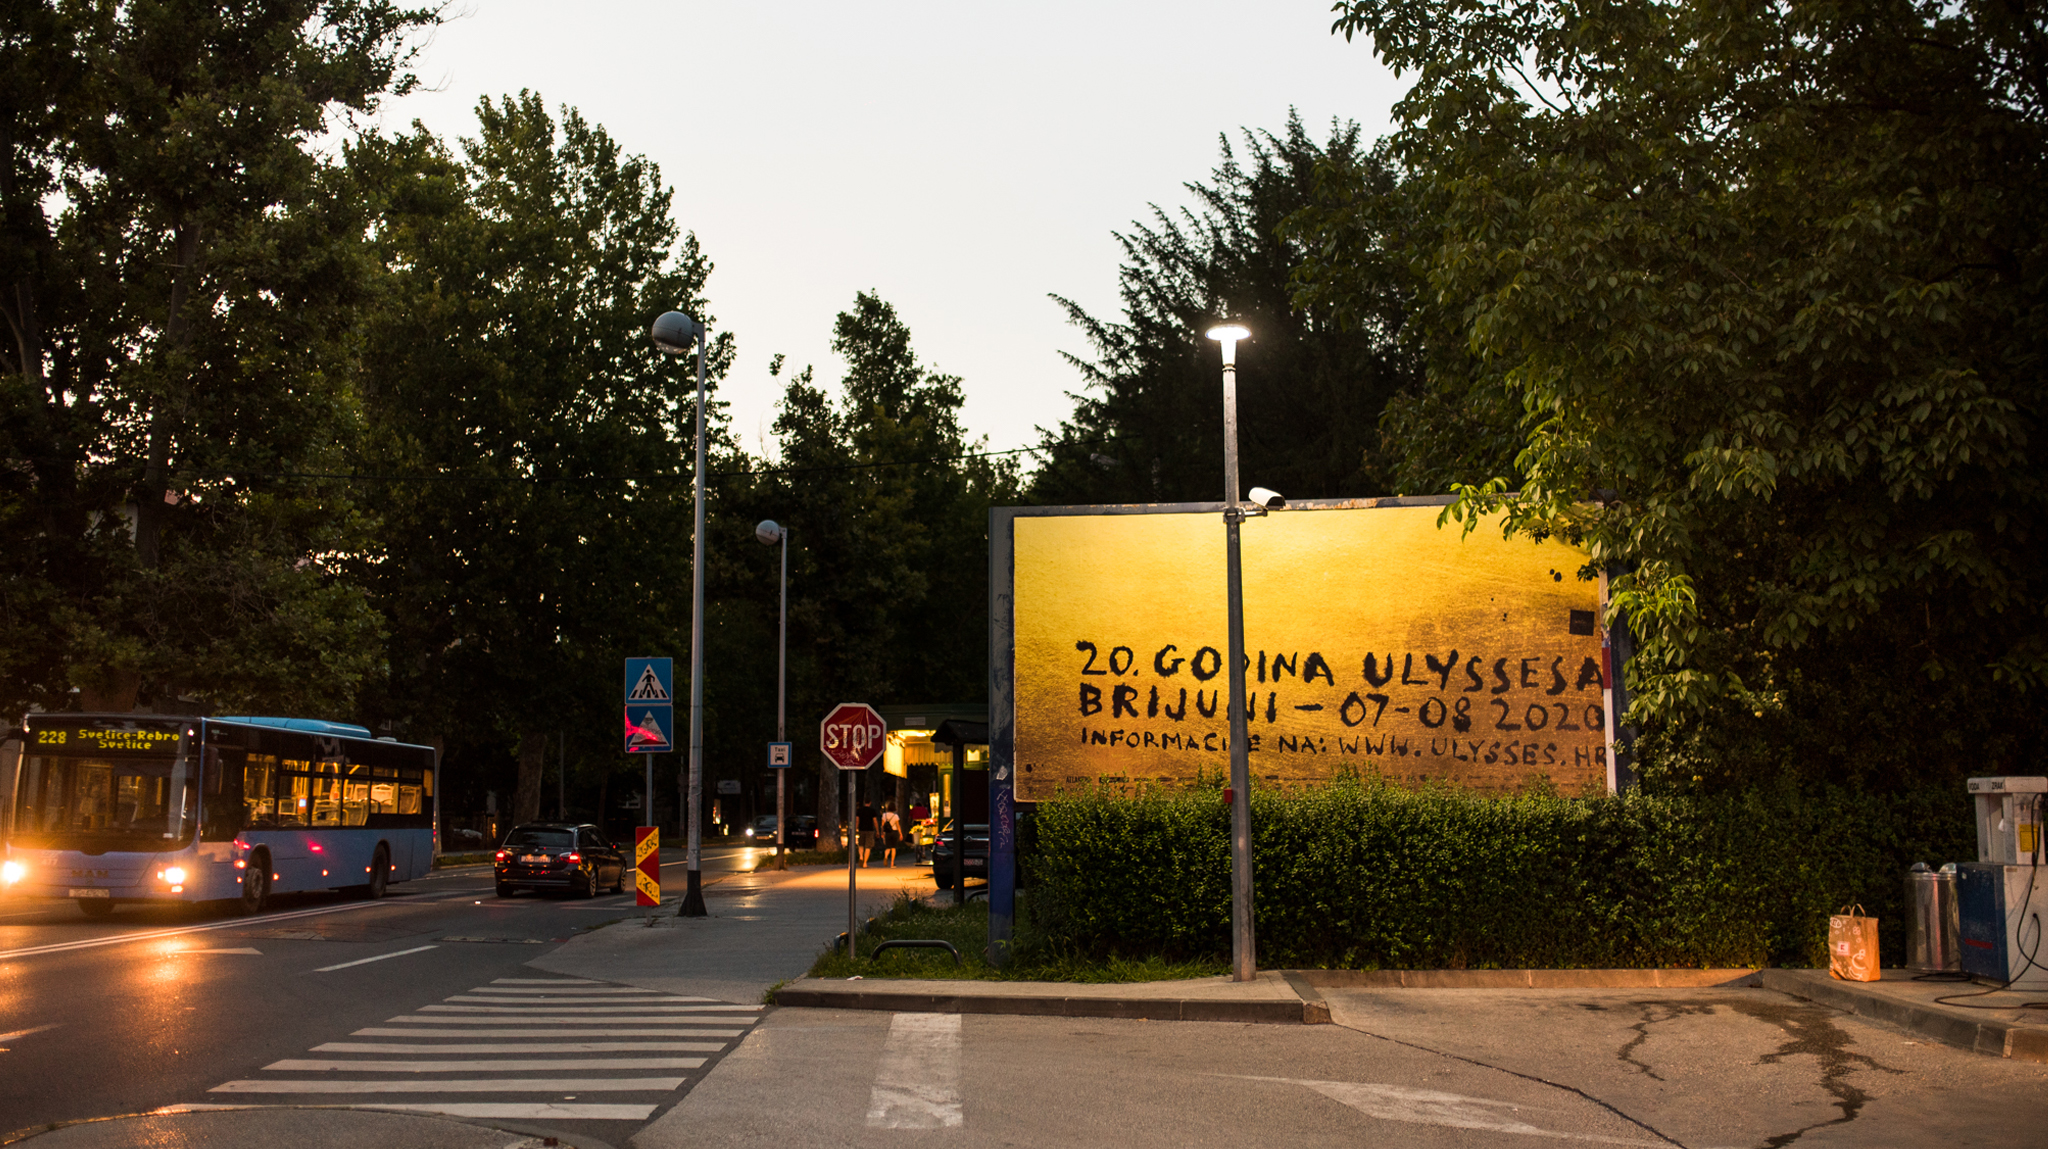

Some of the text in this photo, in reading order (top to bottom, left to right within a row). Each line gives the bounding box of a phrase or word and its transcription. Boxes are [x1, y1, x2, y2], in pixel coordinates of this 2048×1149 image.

[1076, 640, 1139, 677] 20.
[1363, 649, 1603, 696] ULYSSESA
[1340, 691, 1472, 734] 07-08
[1490, 698, 1605, 732] 2020
[39, 729, 180, 744] 228 Svetice-Rebro
[98, 739, 152, 749] Svetice
[825, 723, 882, 749] STOP
[1081, 727, 1261, 752] INFORMACIE
[1278, 735, 1327, 755] NA:
[1991, 781, 2004, 790] ZRAK
[71, 870, 109, 878] MAN
